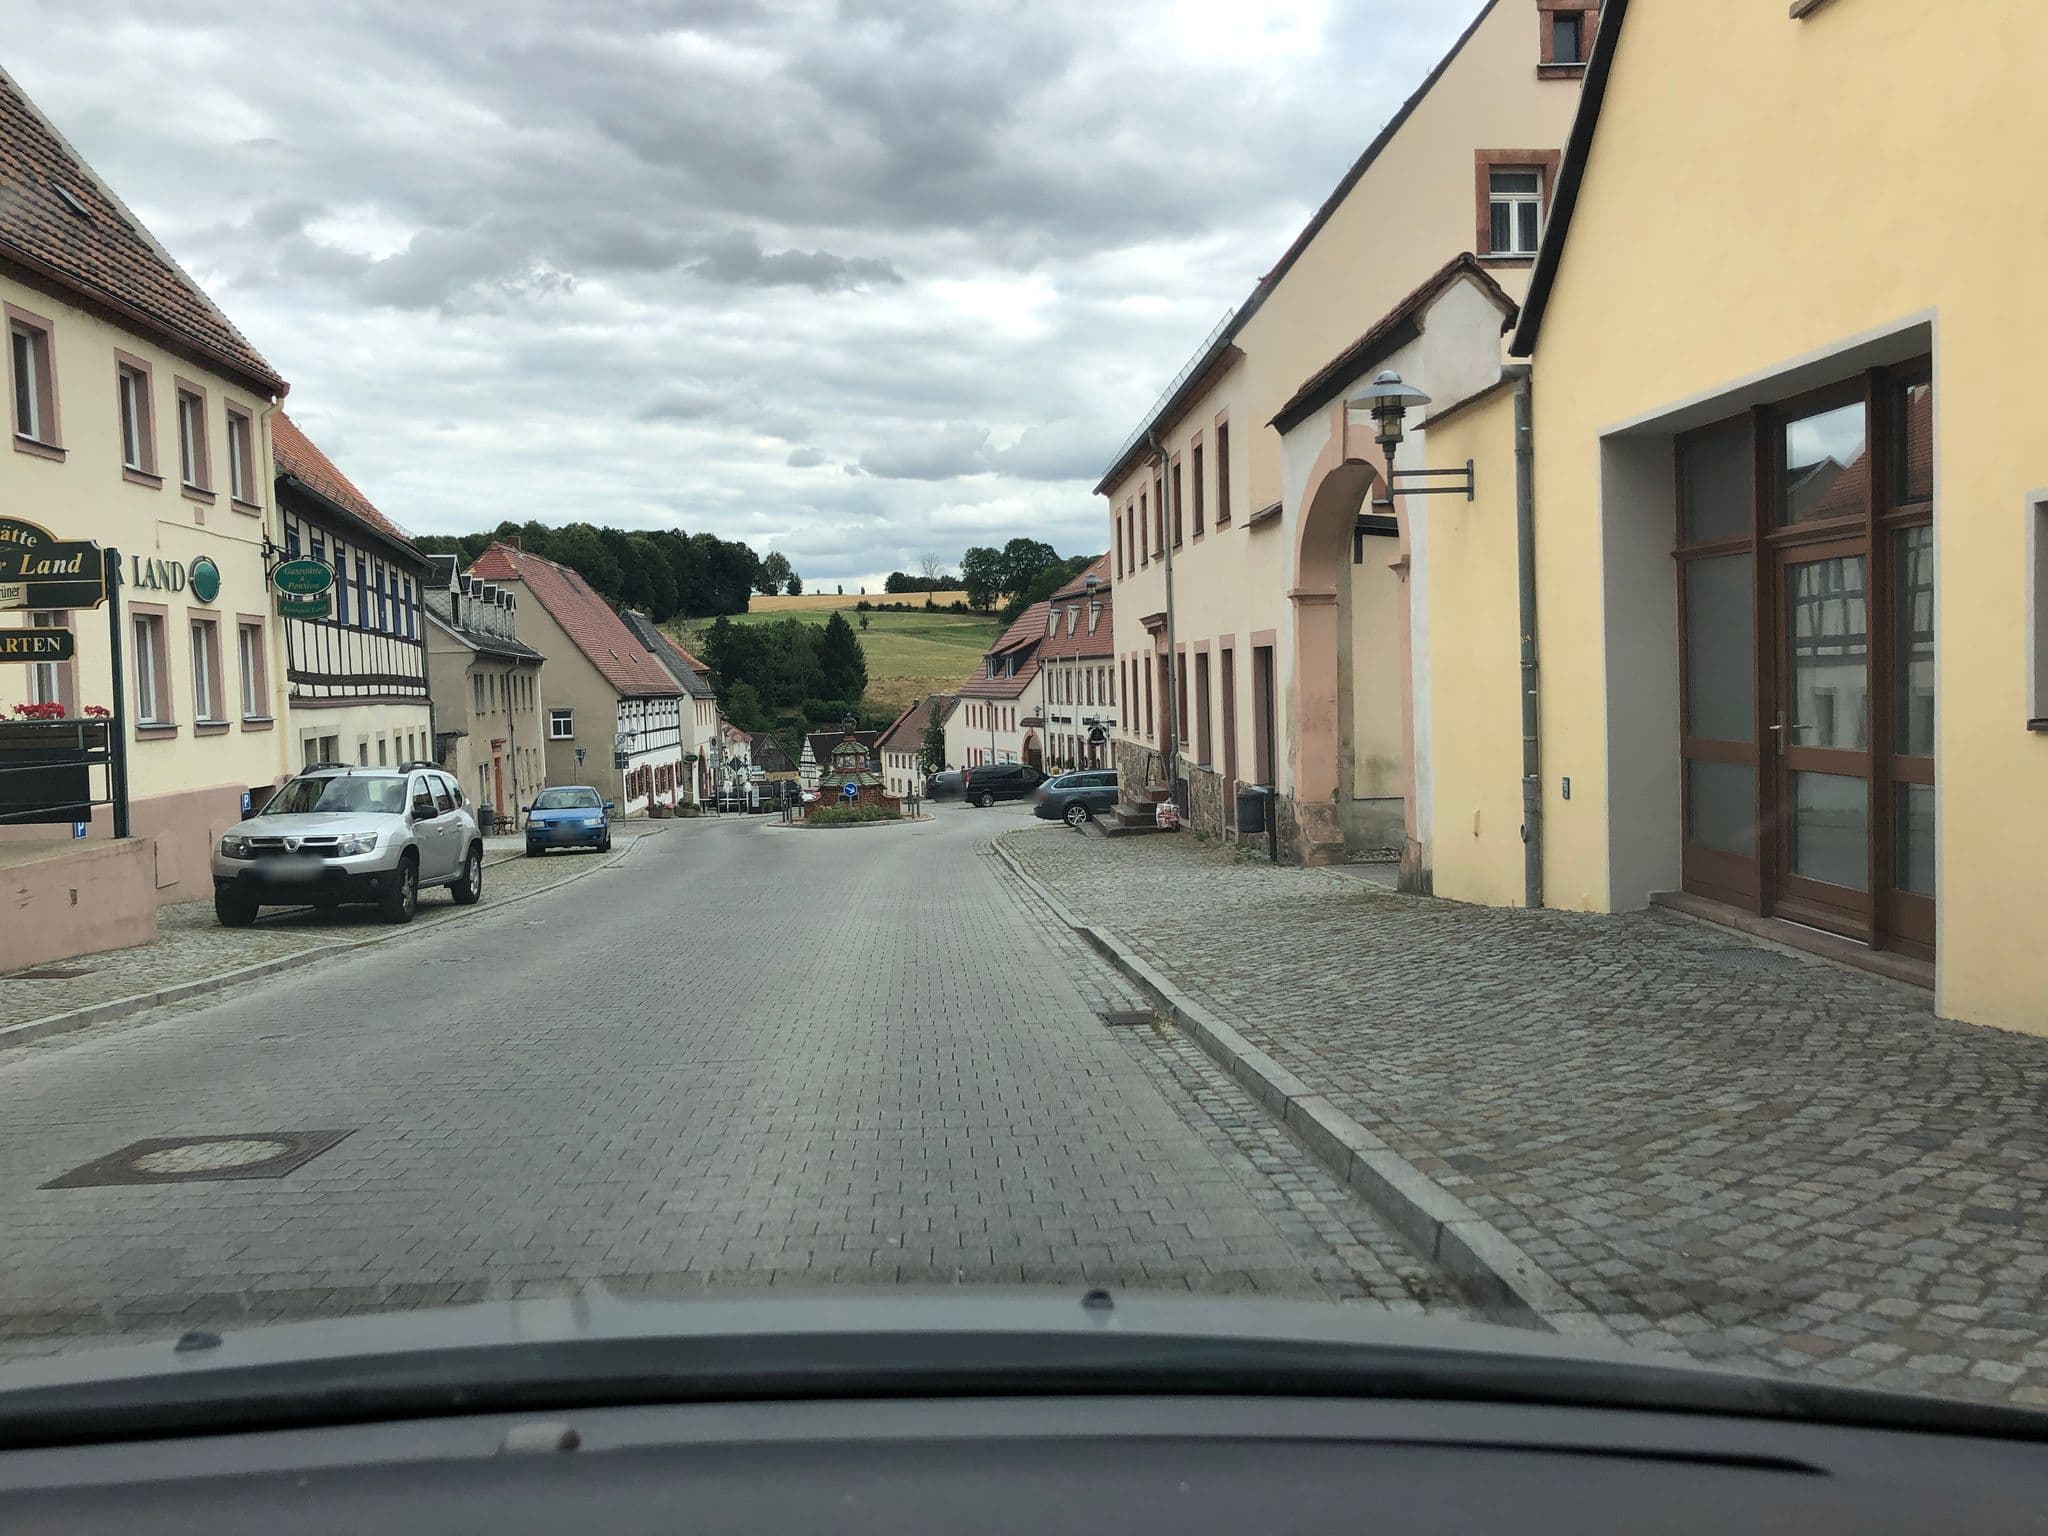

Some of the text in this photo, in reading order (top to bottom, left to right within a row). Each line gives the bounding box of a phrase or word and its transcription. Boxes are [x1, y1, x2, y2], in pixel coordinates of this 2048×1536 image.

[18, 552, 83, 576] Land
[131, 555, 186, 592] LAND
[288, 582, 320, 590] Pension
[0, 637, 61, 653] RTEN
